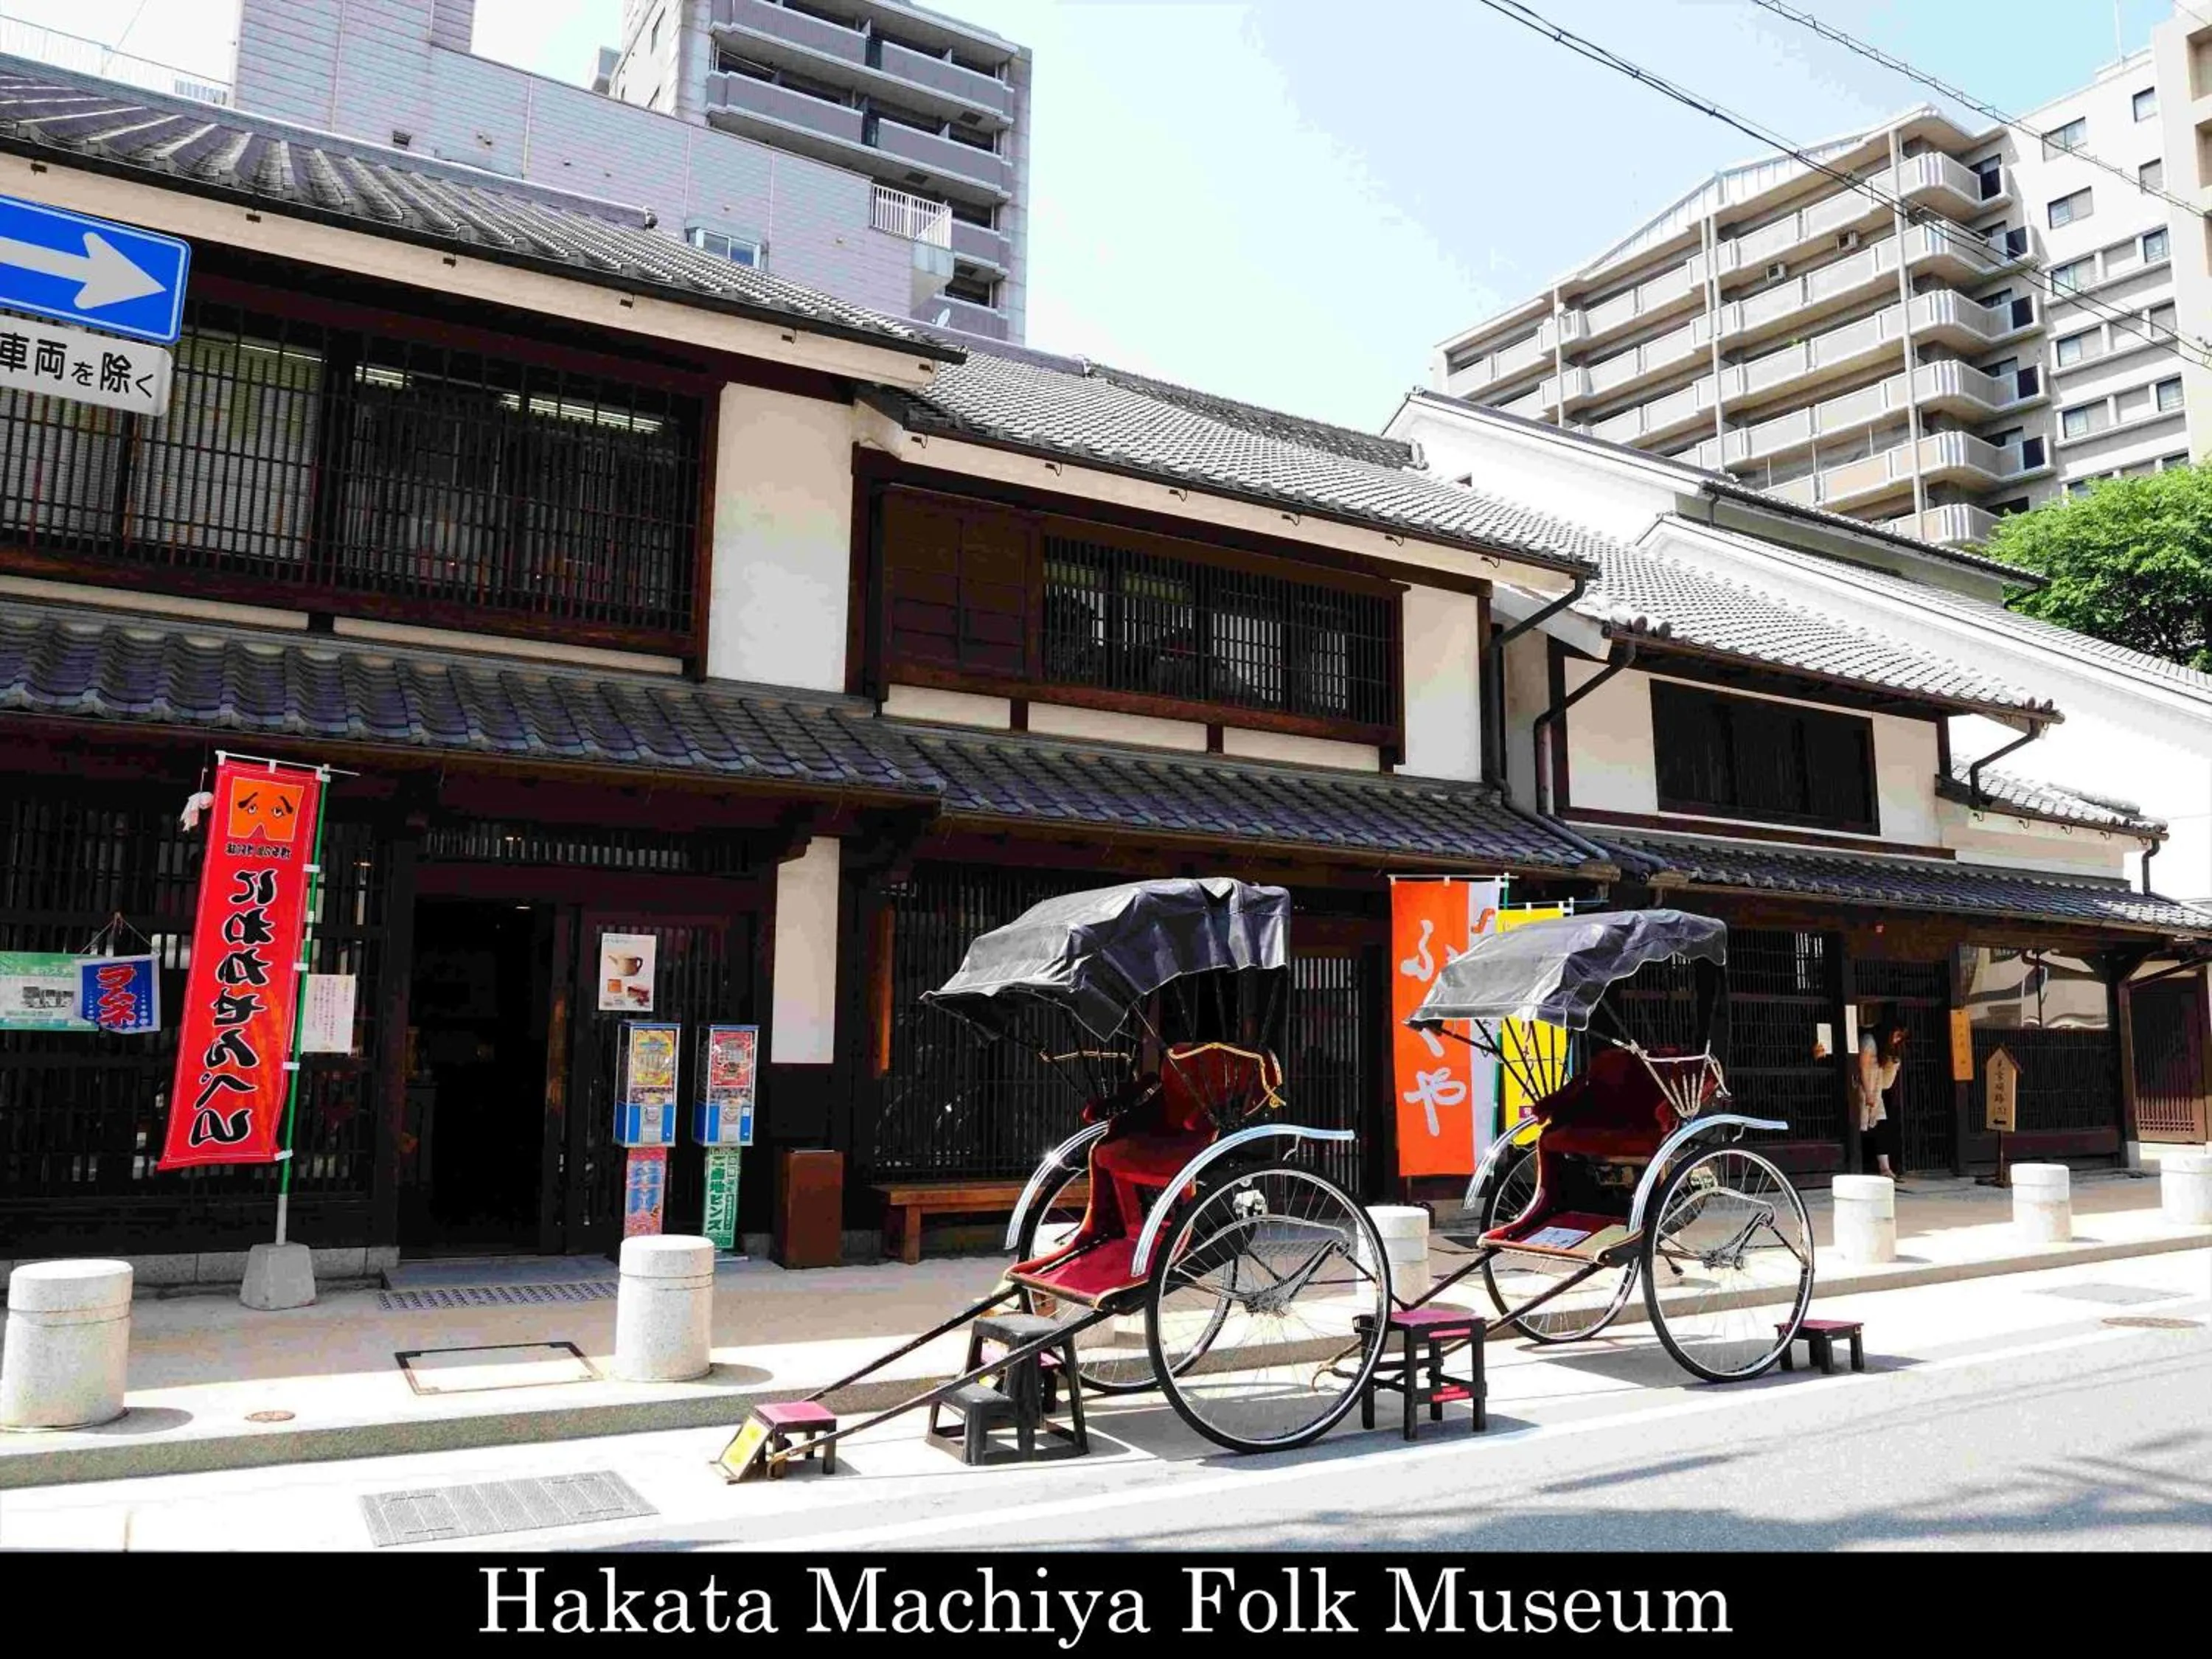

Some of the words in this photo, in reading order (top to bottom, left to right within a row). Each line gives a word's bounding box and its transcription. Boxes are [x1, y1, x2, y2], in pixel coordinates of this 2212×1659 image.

[0, 333, 154, 398] 車両を除く
[1400, 919, 1467, 1137] ふや
